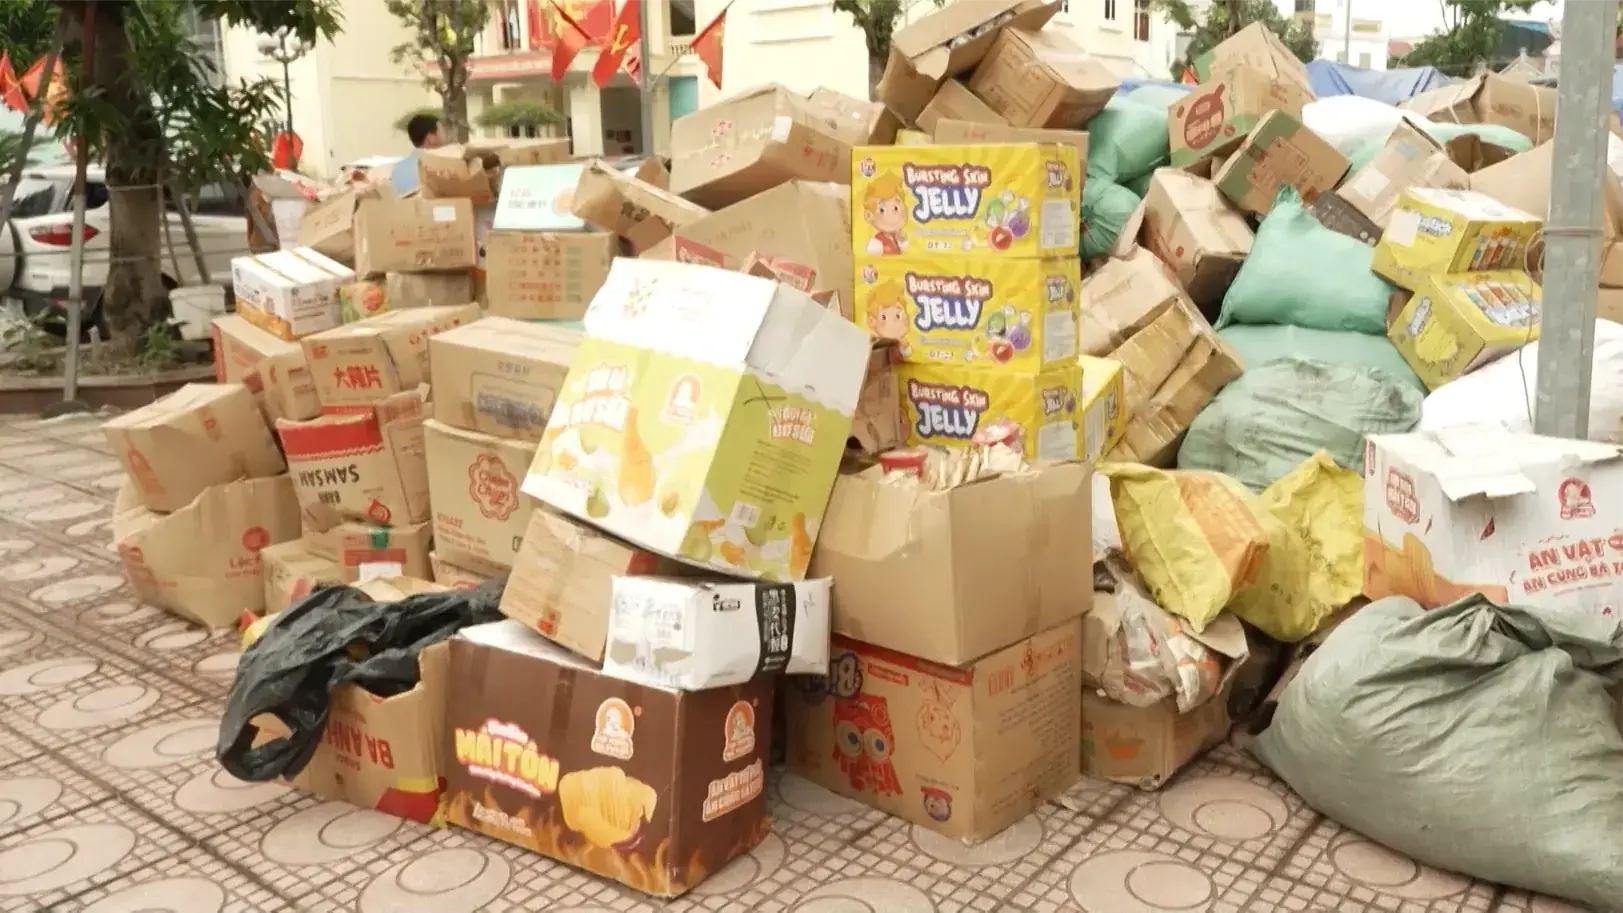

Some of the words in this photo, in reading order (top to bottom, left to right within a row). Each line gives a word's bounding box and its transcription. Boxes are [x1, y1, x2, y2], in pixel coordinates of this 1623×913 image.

[914, 186, 980, 220] JELLY
[916, 295, 981, 329] JELLY
[917, 401, 978, 436] JELLY
